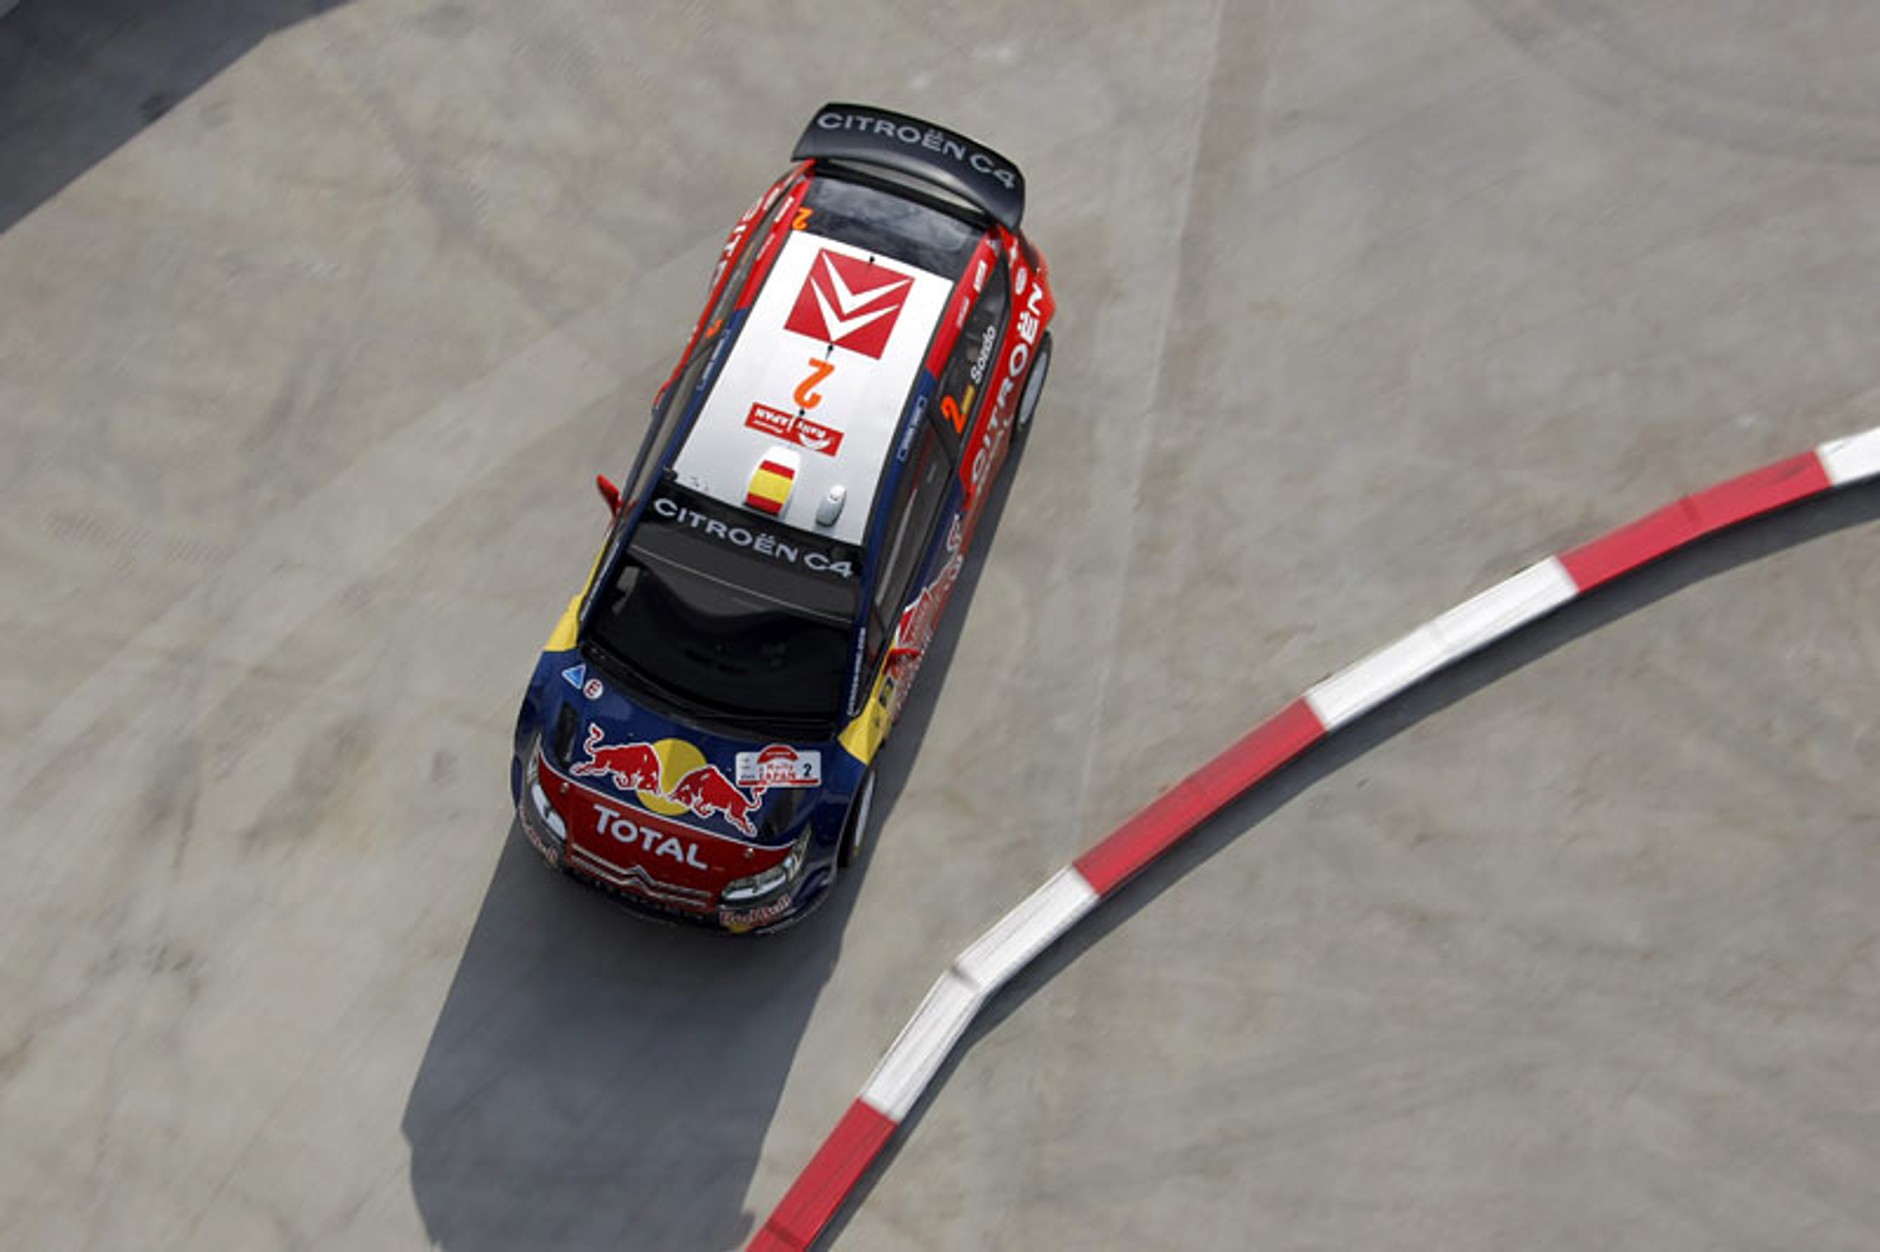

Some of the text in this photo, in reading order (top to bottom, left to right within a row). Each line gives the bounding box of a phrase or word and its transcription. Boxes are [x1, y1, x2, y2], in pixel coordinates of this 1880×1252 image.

[817, 112, 1017, 190] CITROËN C4
[792, 207, 813, 230] 2
[793, 357, 836, 411] 2
[970, 325, 997, 385] Sordo
[971, 283, 1044, 484] CITROËN
[940, 395, 968, 434] 2
[654, 497, 854, 579] CITROËN C4
[802, 762, 813, 778] 2
[593, 804, 709, 870] TOTAL
